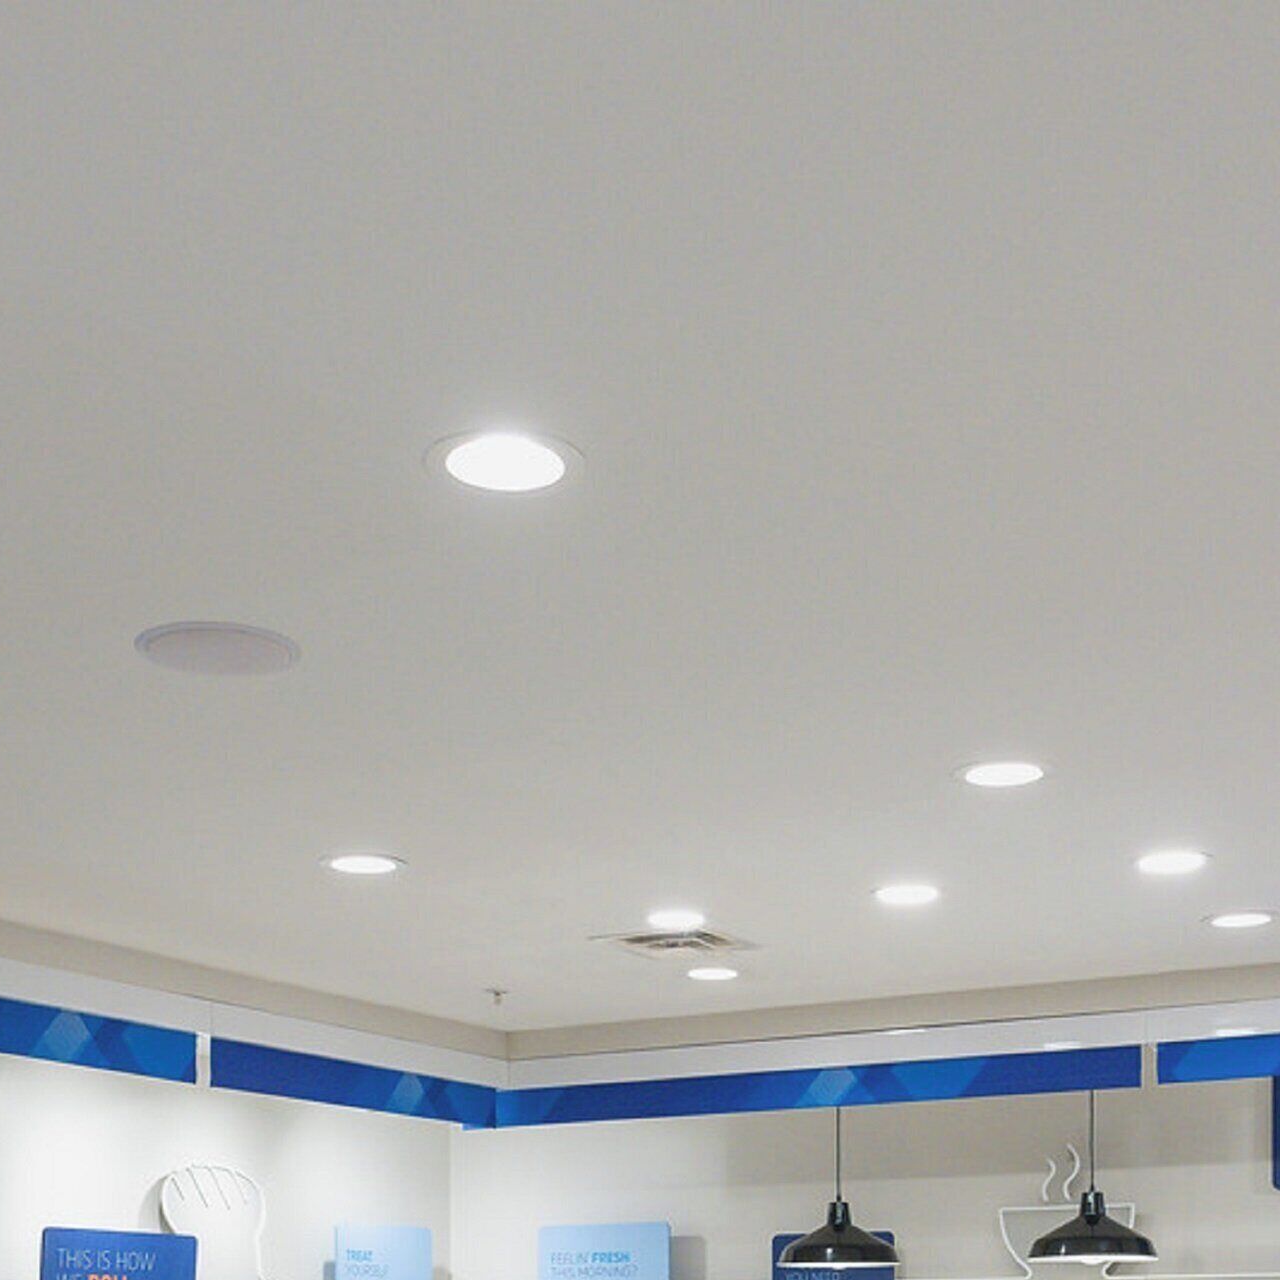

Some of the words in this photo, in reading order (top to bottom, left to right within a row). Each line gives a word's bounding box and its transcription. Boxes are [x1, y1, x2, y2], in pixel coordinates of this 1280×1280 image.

[57, 1248, 94, 1271] THIS
[97, 1250, 111, 1271] IS
[116, 1251, 157, 1272] HOW
[591, 1251, 631, 1264] FRESH
[550, 1266, 574, 1278] THIS
[578, 1264, 639, 1279] MORNING?
